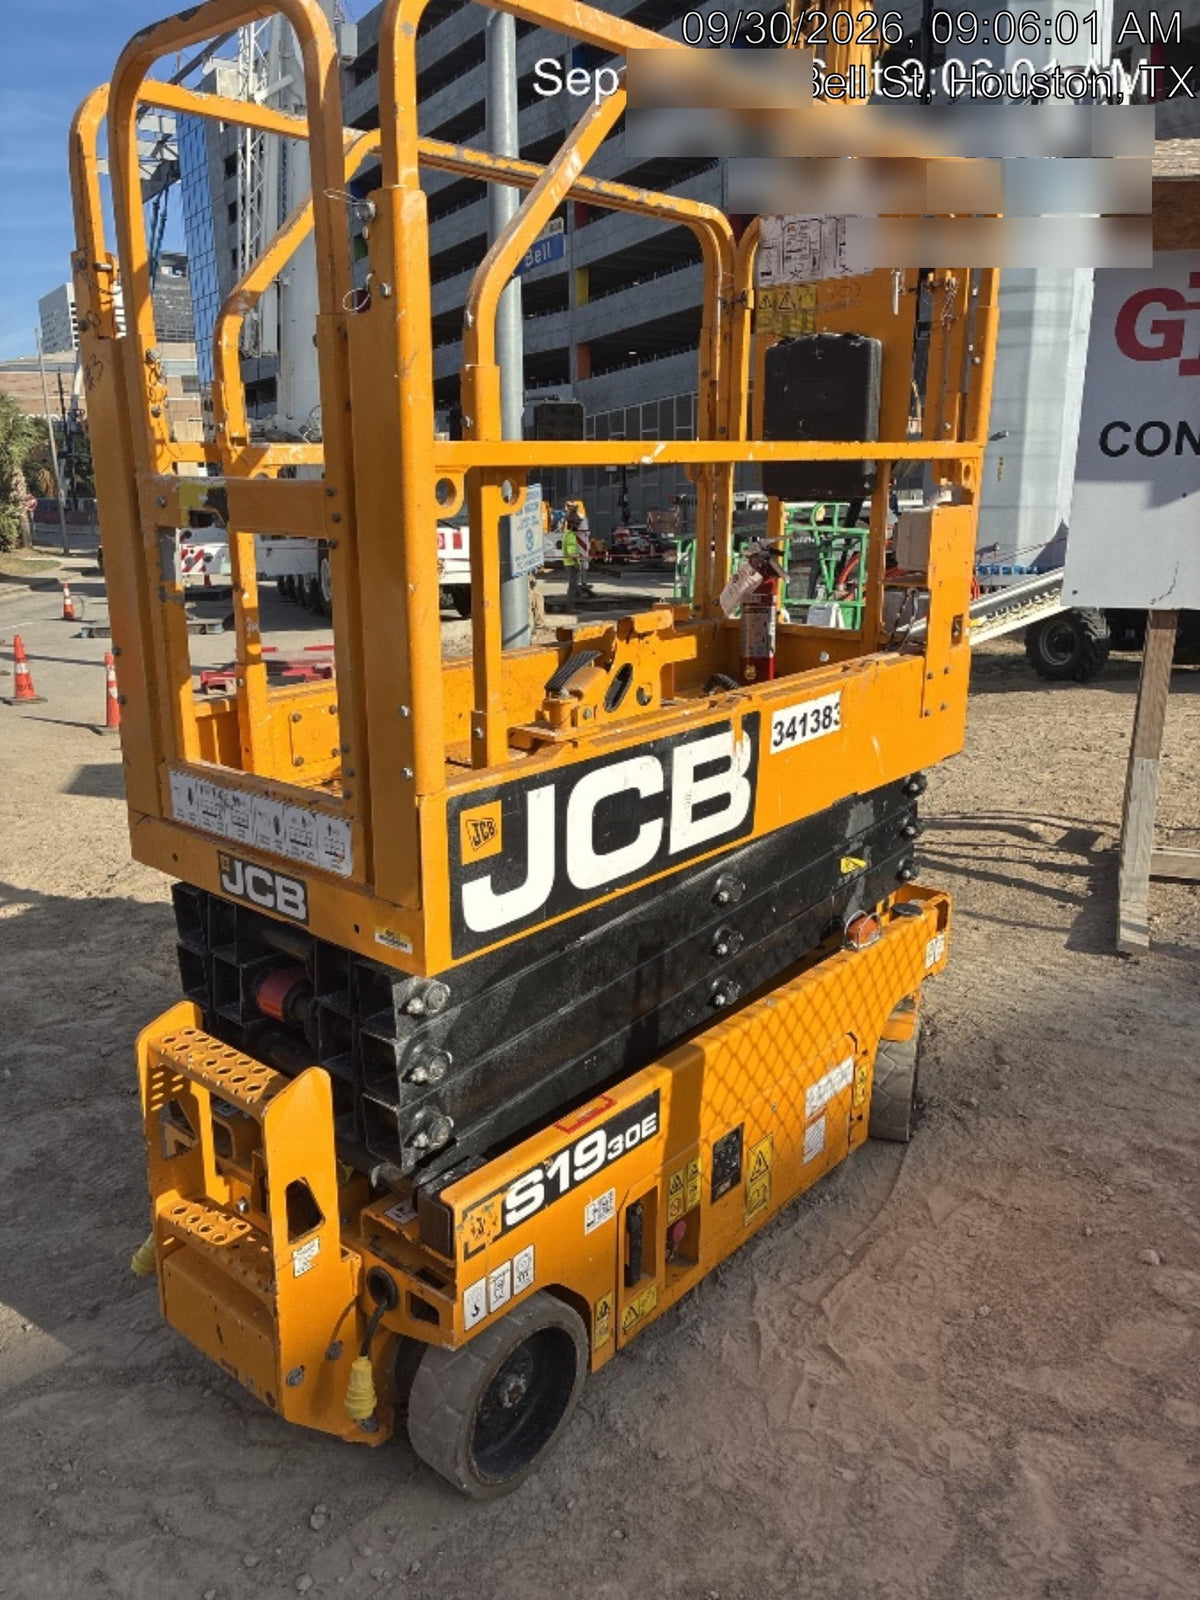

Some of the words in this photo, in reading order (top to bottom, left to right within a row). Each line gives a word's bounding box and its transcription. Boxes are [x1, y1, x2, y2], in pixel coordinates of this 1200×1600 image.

[461, 725, 751, 932] JCB
[471, 820, 495, 847] JCB
[222, 860, 307, 920] JCB
